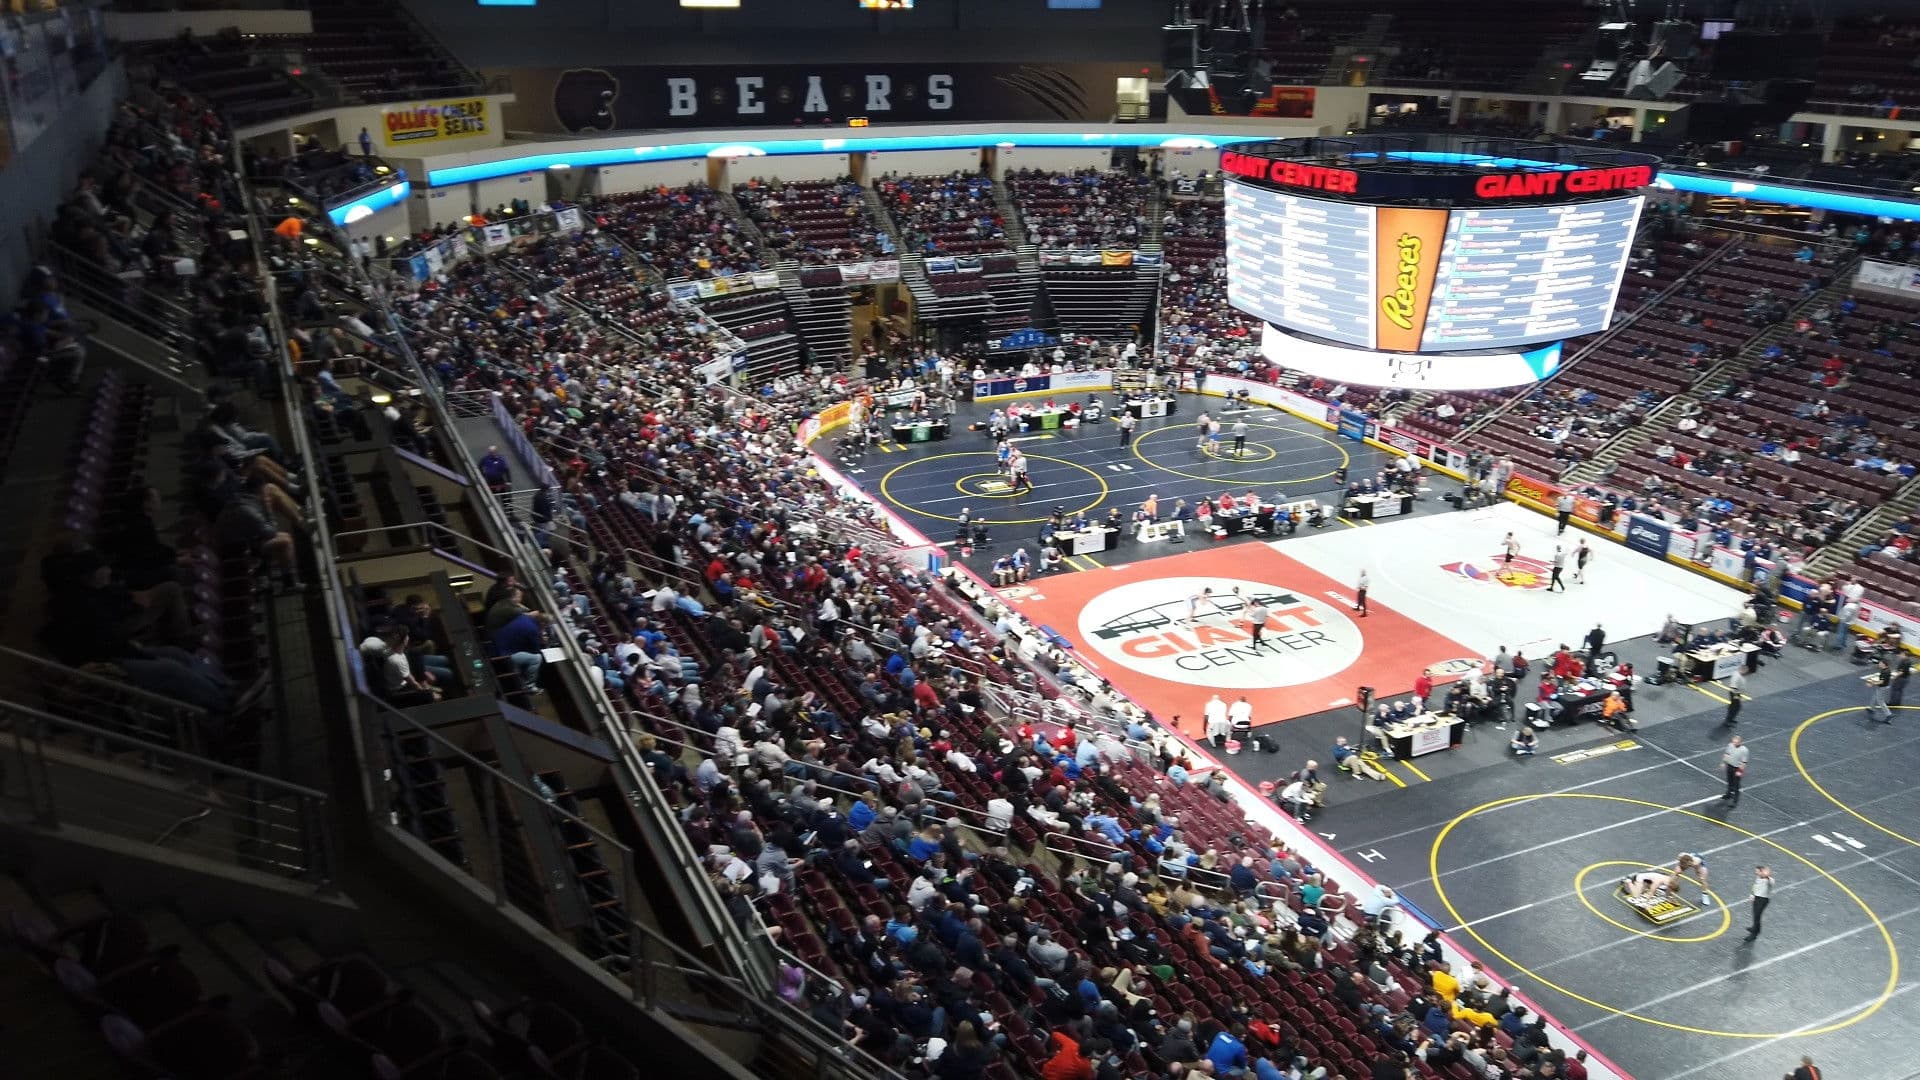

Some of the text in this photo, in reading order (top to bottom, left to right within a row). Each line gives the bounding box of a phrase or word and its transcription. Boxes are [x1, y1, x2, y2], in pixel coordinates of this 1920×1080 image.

[442, 101, 483, 120] CHEAP
[667, 74, 954, 116] BEARS
[445, 117, 484, 136] SEATS
[1221, 152, 1359, 194] GIANT CENTER
[1476, 166, 1652, 198] GIANT CENTER
[1442, 239, 1457, 256] 2
[1382, 233, 1421, 330] Reese's
[1437, 261, 1451, 278] 3
[1121, 605, 1323, 659] GIANT
[1175, 630, 1336, 671] CENTER
